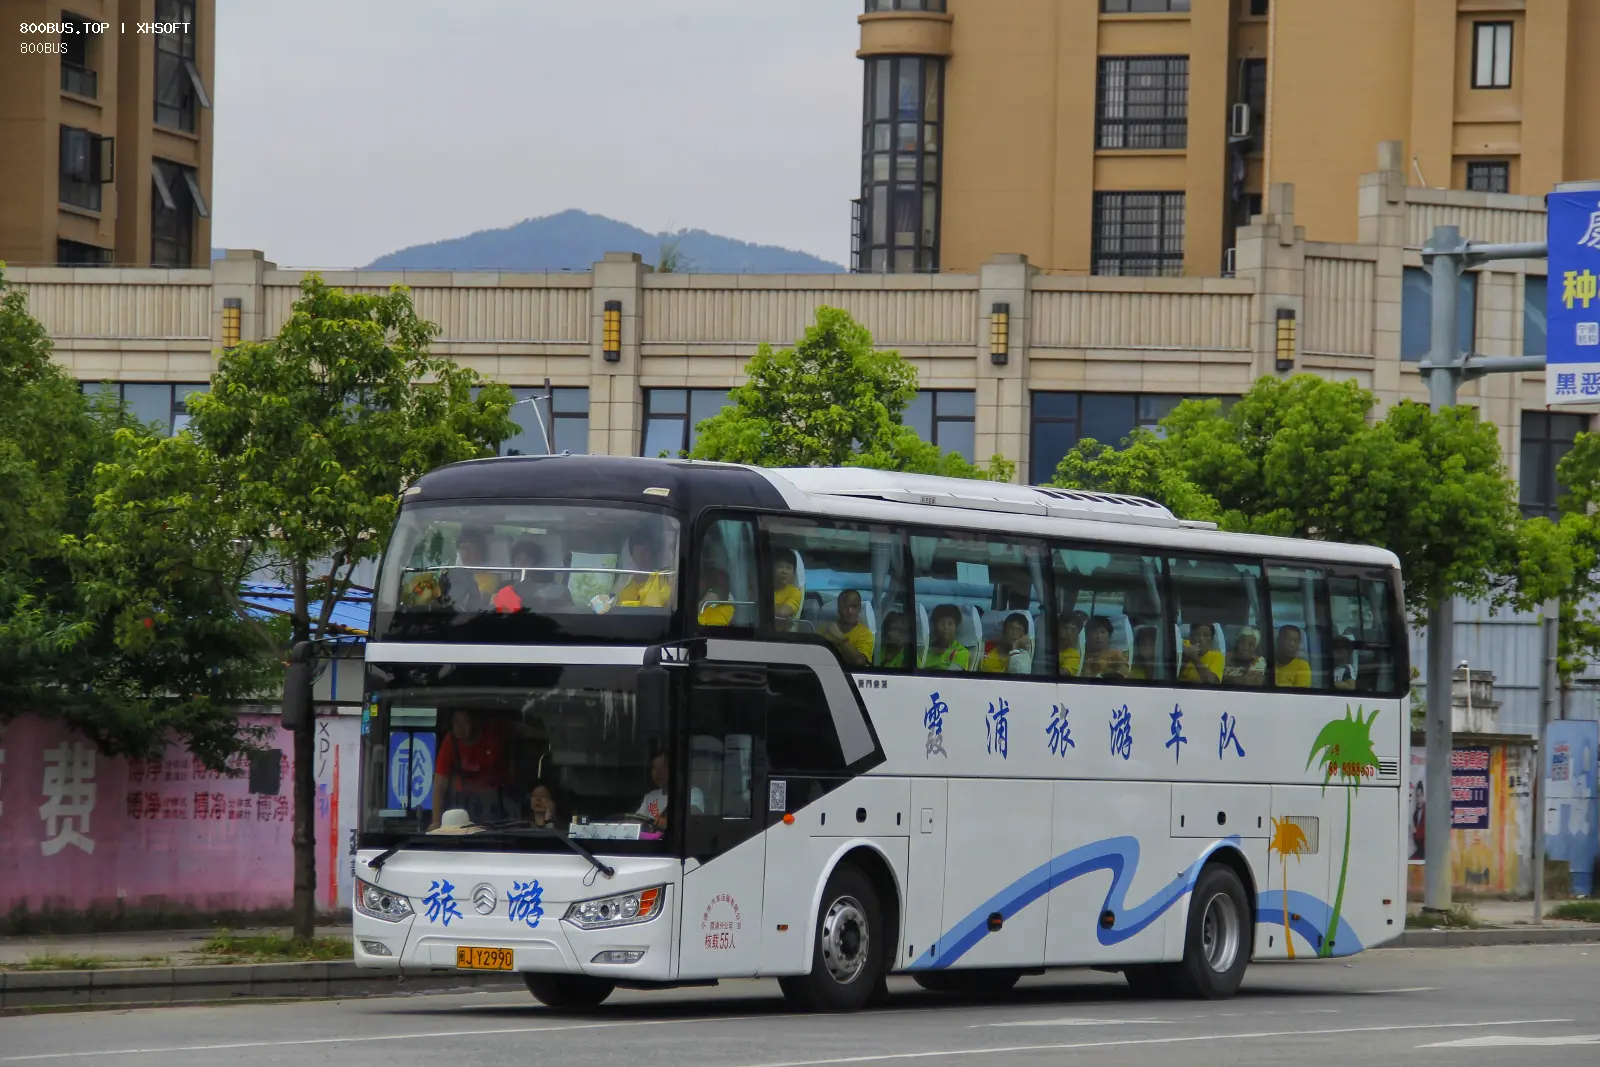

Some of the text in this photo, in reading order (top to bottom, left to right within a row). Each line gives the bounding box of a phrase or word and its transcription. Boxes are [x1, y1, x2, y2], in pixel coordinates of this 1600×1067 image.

[1562, 269, 1600, 309] 种
[704, 932, 736, 949] 核载55人
